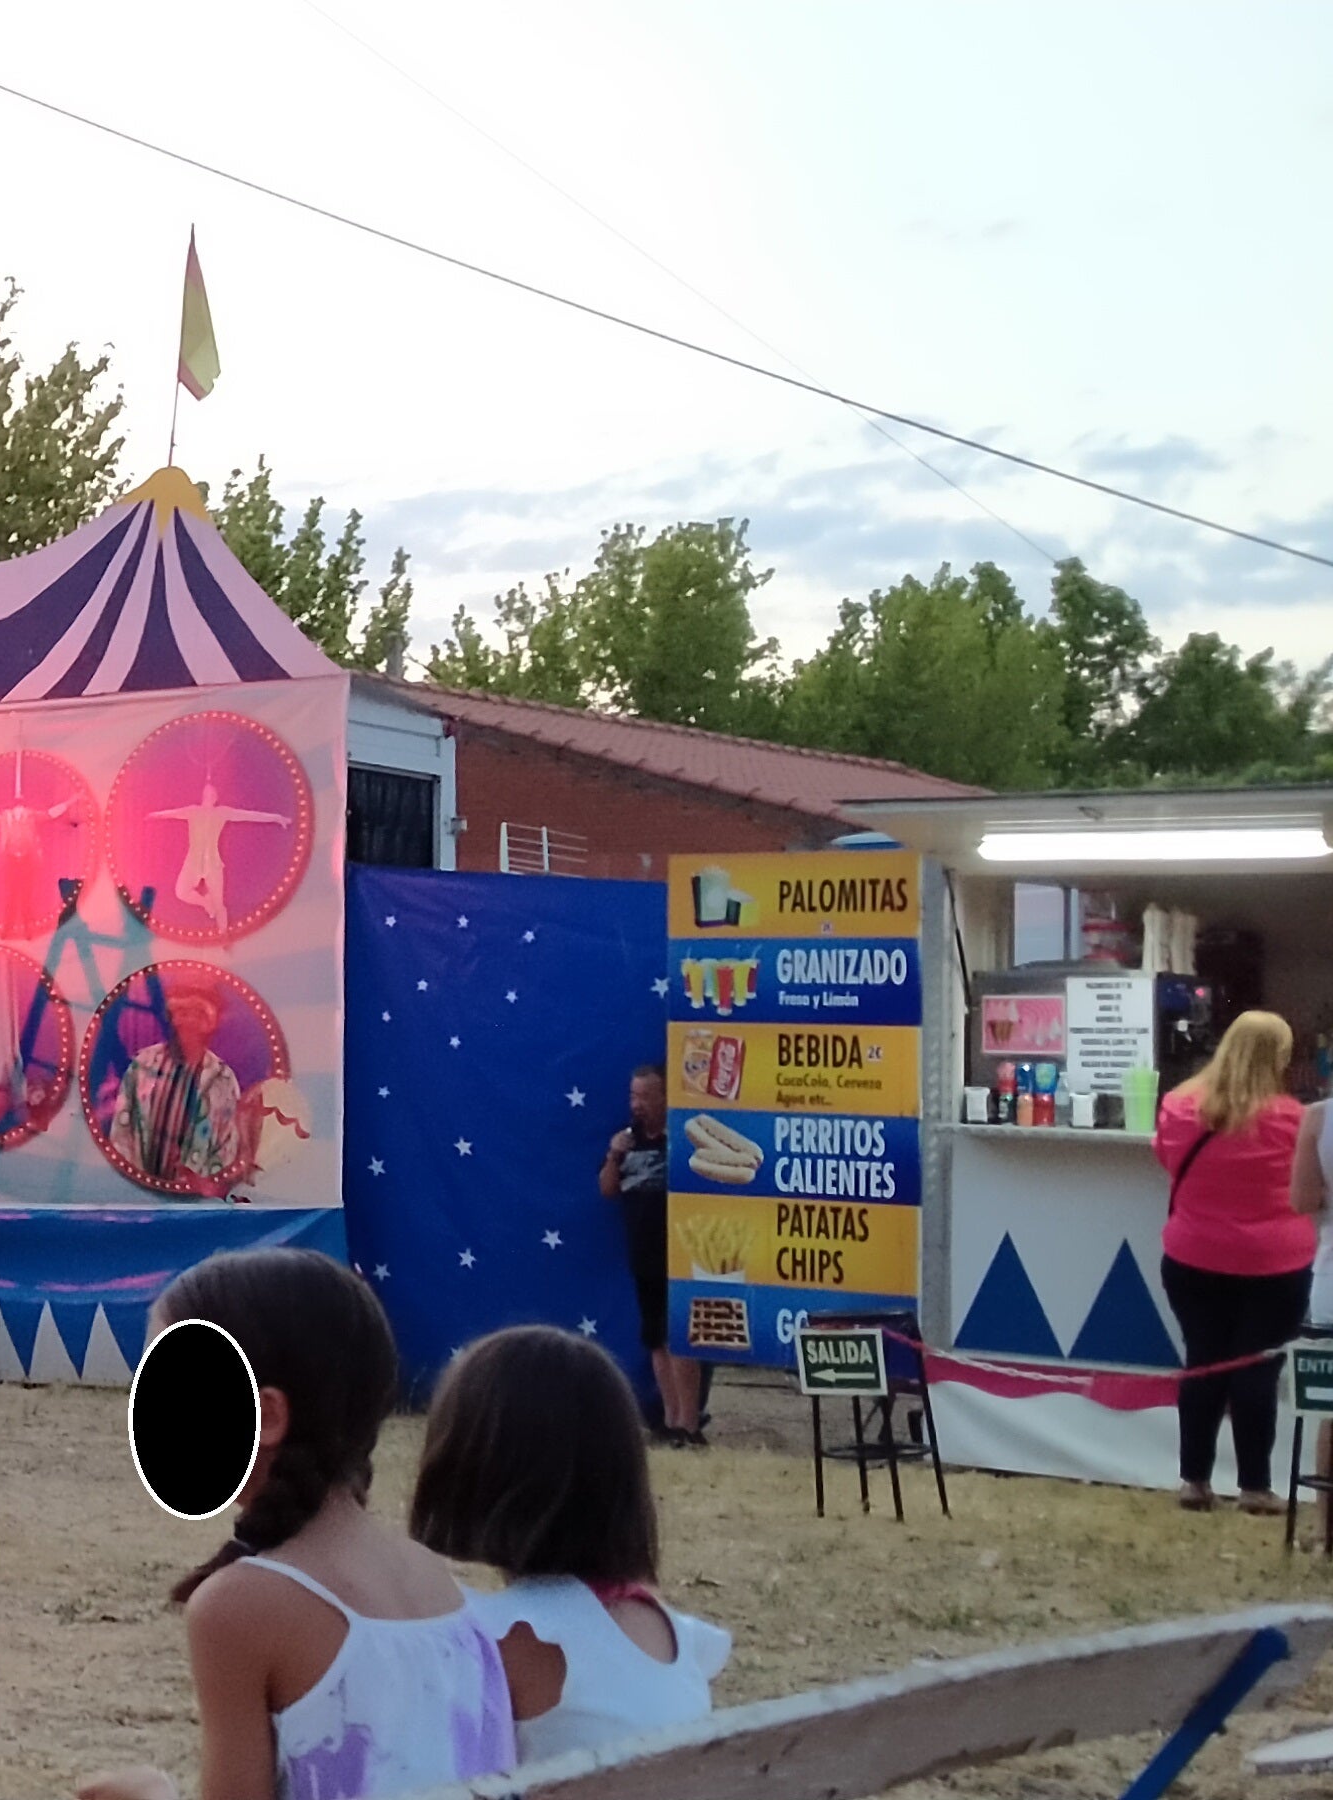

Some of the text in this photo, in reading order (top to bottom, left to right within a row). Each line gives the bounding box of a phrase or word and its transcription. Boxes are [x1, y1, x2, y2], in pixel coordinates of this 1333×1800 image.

[778, 878, 909, 913] PALOMITAS
[776, 949, 908, 985] GRANIZADO
[812, 994, 821, 1010] y
[777, 1033, 863, 1070] BEBIDA
[774, 1117, 886, 1157] PERRITOS
[774, 1157, 896, 1199] CALIENTES
[776, 1203, 870, 1243] PATATAS
[776, 1247, 845, 1284] CHIPS
[805, 1340, 874, 1365] SALIDA
